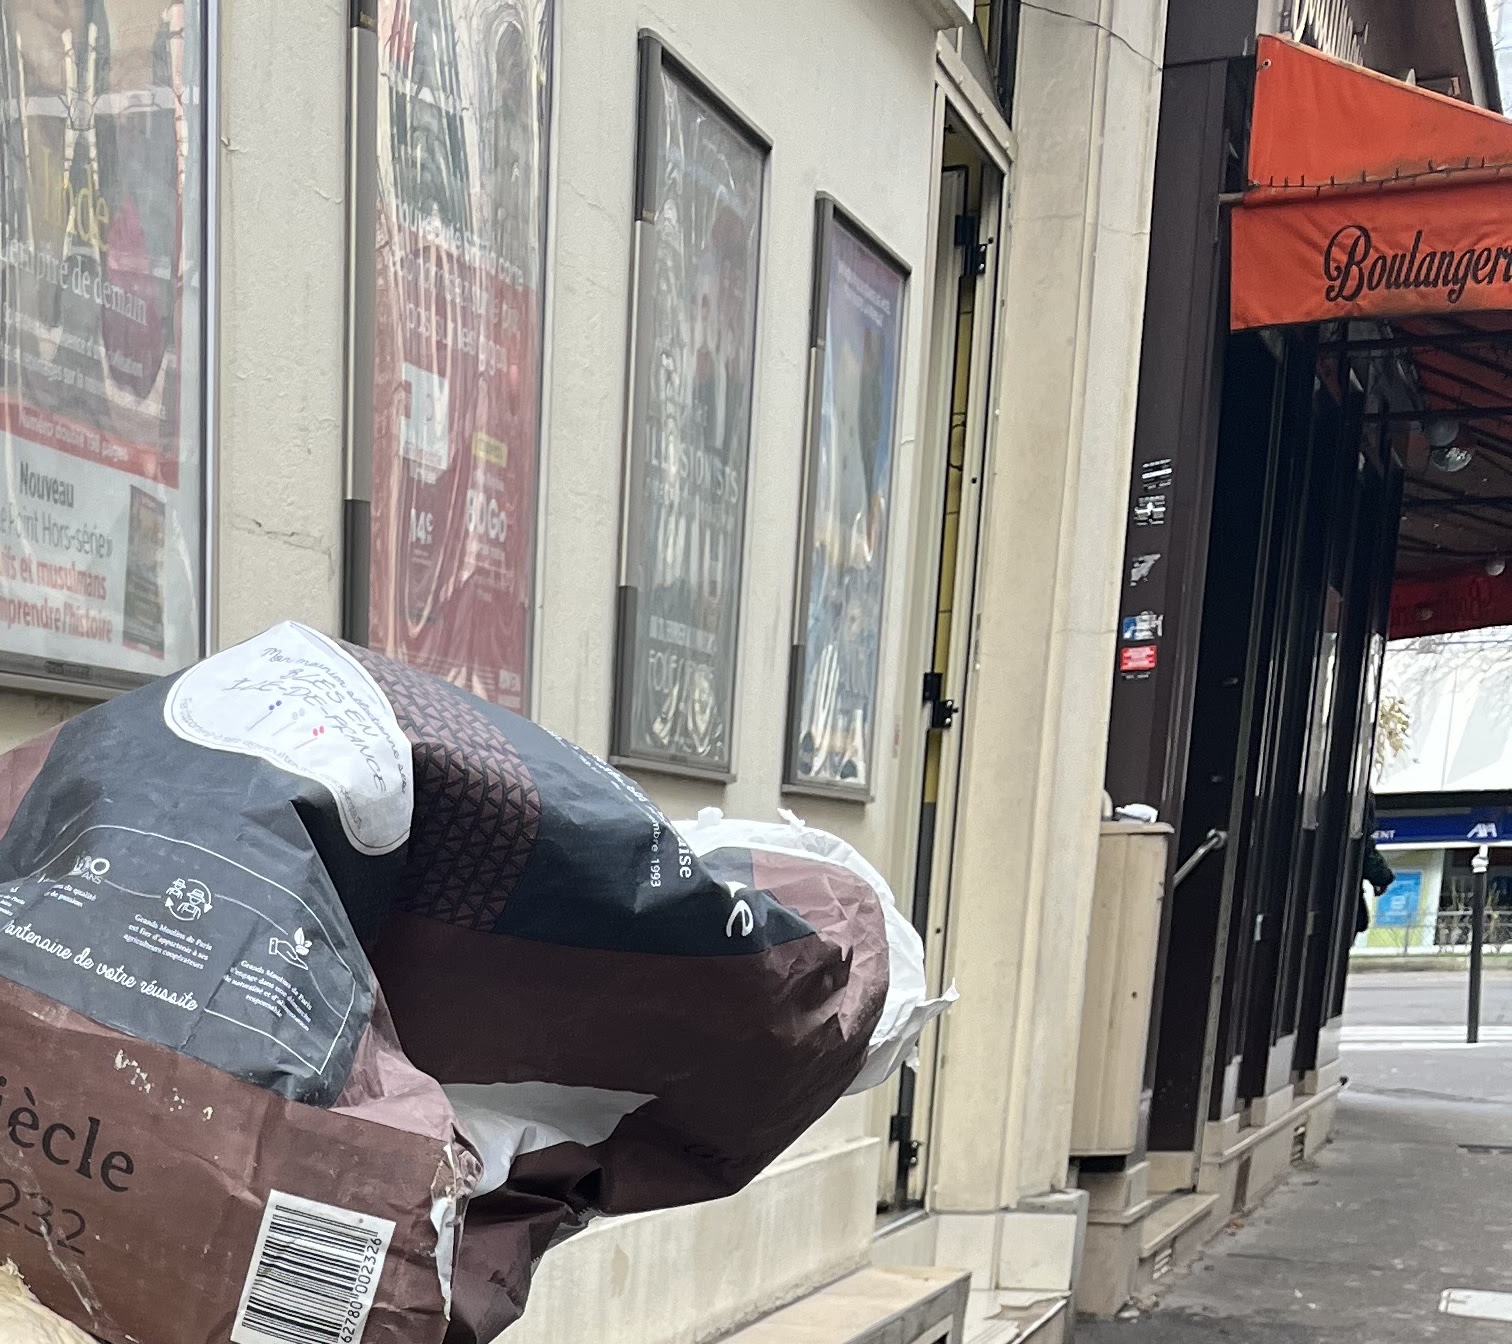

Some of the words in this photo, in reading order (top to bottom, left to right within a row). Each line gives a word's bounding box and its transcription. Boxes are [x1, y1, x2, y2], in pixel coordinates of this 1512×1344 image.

[19, 461, 76, 508] Nouveau
[38, 561, 107, 600] musulmans
[345, 709, 379, 737] EN
[650, 858, 662, 887] 1993
[74, 947, 94, 970] de
[95, 965, 137, 989] votre
[140, 979, 199, 1012] réussite
